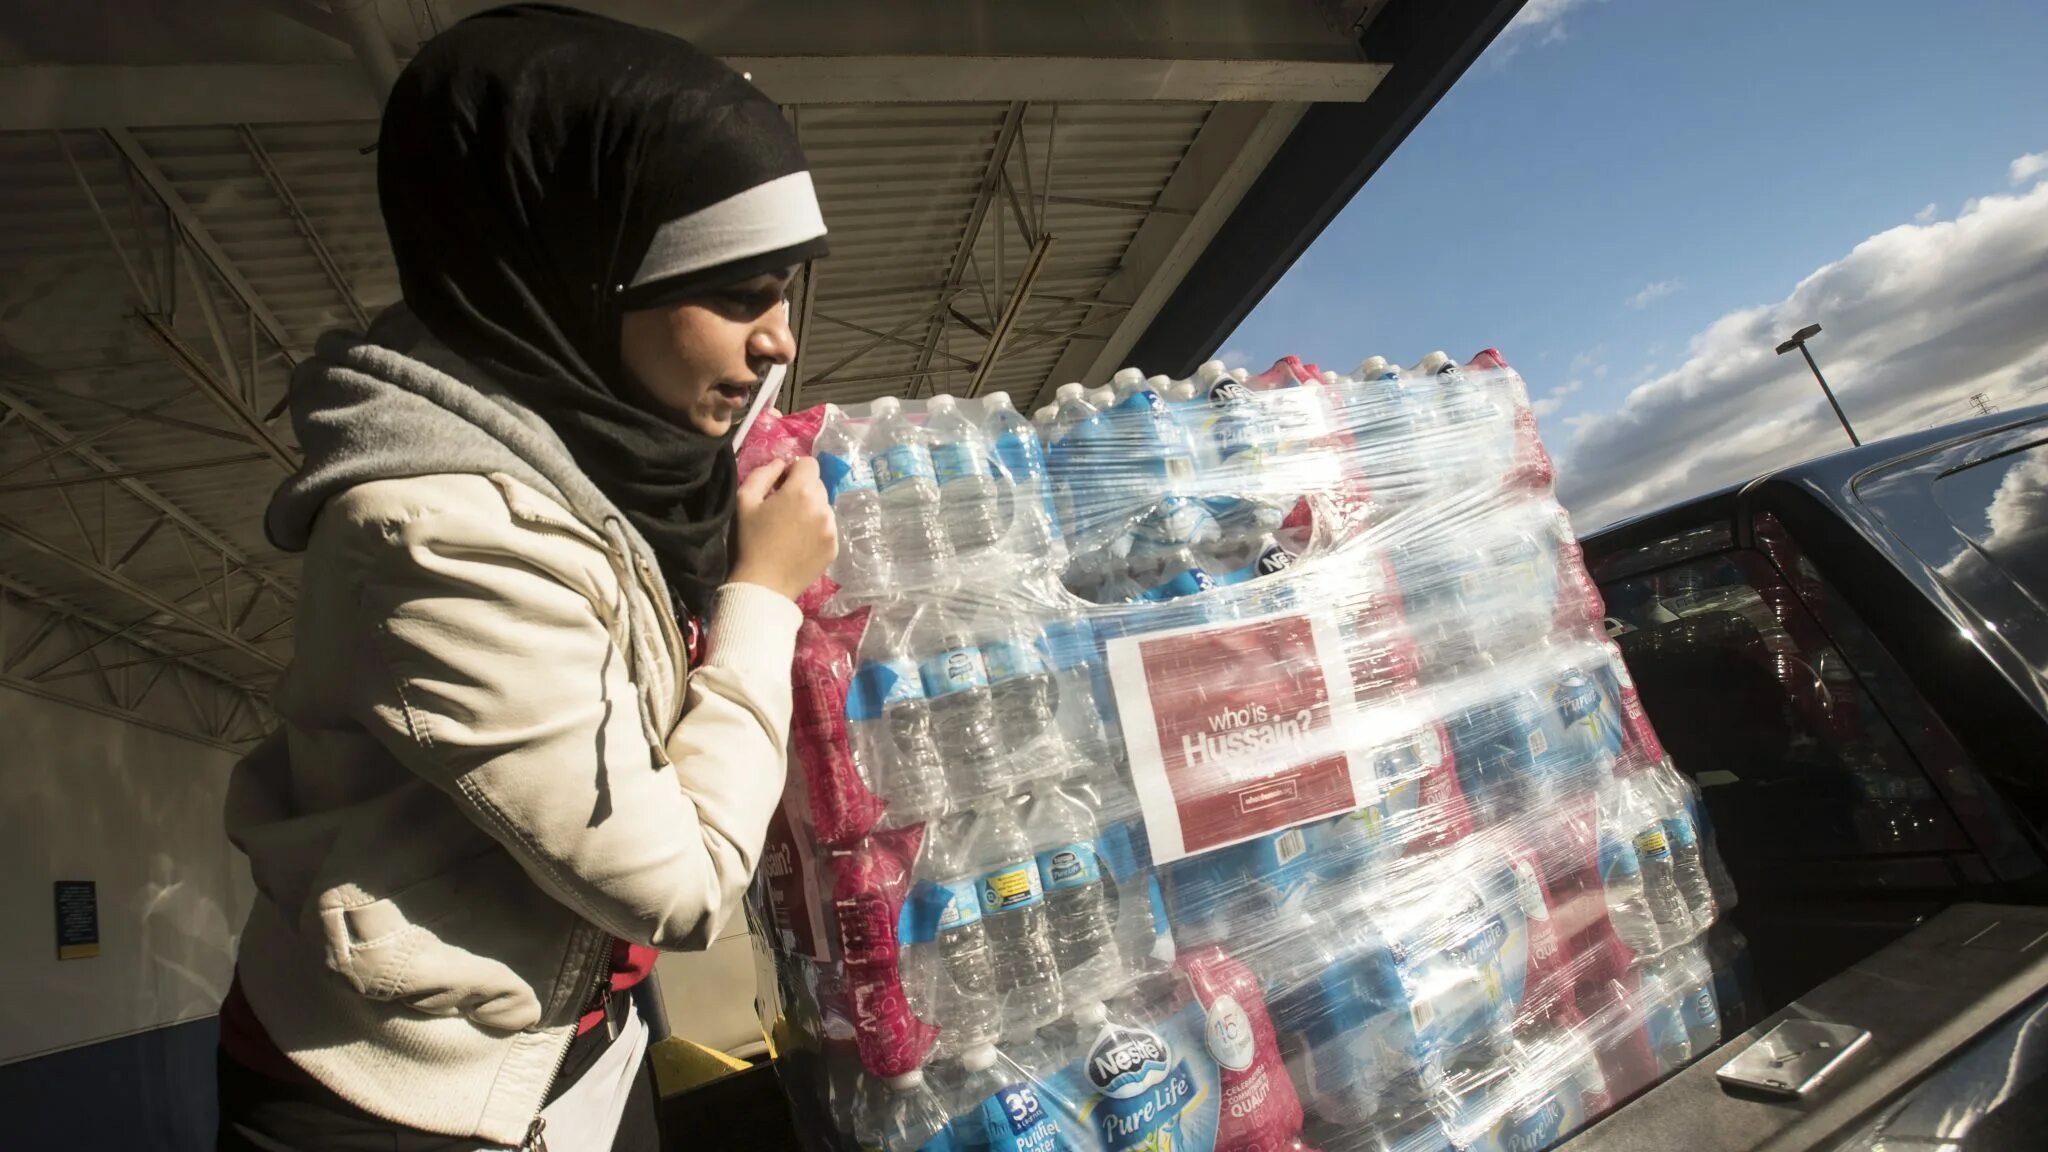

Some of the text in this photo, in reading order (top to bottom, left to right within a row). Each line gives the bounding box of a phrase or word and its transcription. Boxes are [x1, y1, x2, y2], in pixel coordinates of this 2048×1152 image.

[1208, 702, 1268, 732] who is
[1182, 709, 1313, 768] Hussain?
[1094, 1036, 1160, 1080] Nestlé
[1006, 1088, 1039, 1121] 35
[1102, 1076, 1189, 1144] Pure Life
[1231, 1080, 1270, 1118] QUALITY
